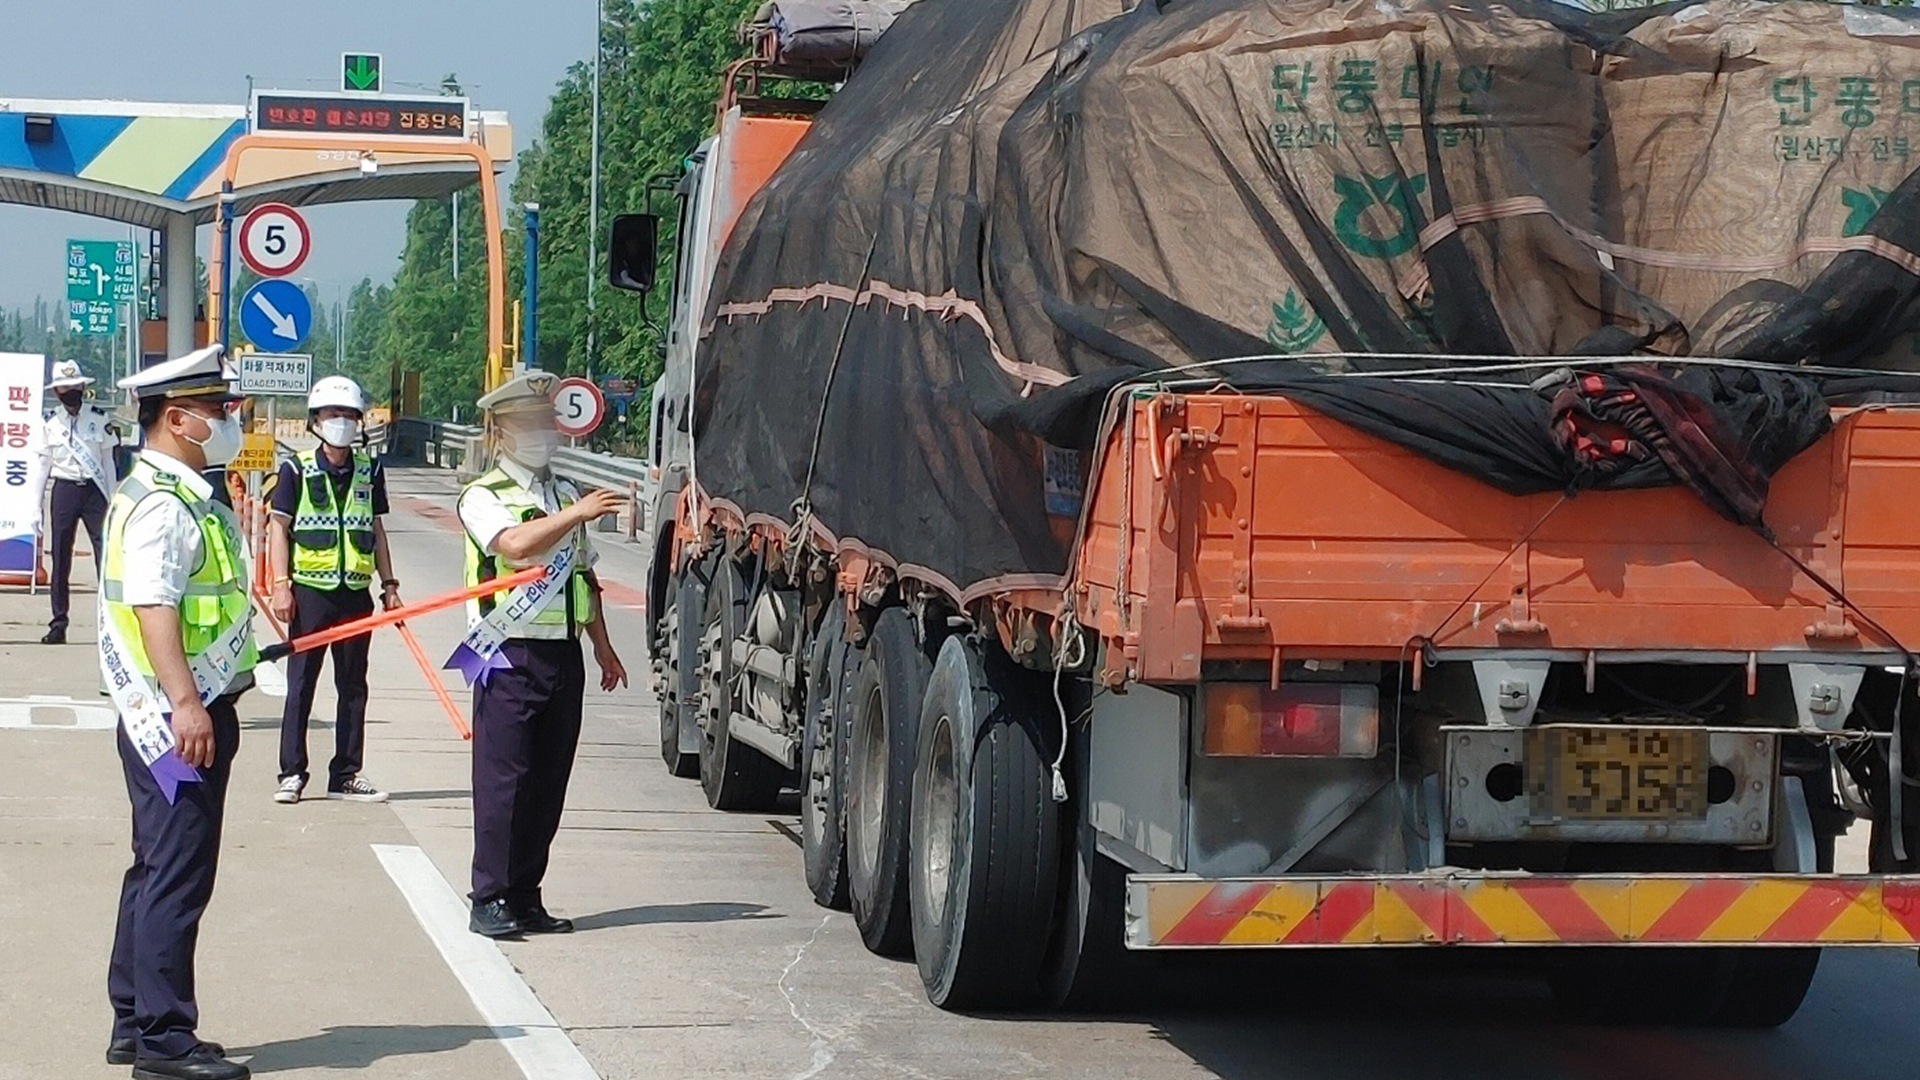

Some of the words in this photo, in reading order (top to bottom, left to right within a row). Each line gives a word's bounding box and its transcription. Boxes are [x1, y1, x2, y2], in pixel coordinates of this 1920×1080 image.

[399, 112, 462, 130] 집중단속
[264, 225, 287, 256] 5
[244, 360, 306, 375] 화물적재차량
[243, 379, 276, 388] LOADED
[278, 379, 305, 389] TRUCK
[8, 386, 31, 412] 판
[567, 392, 582, 419] 5
[6, 459, 28, 487] 중
[506, 577, 549, 622] 보입니다
